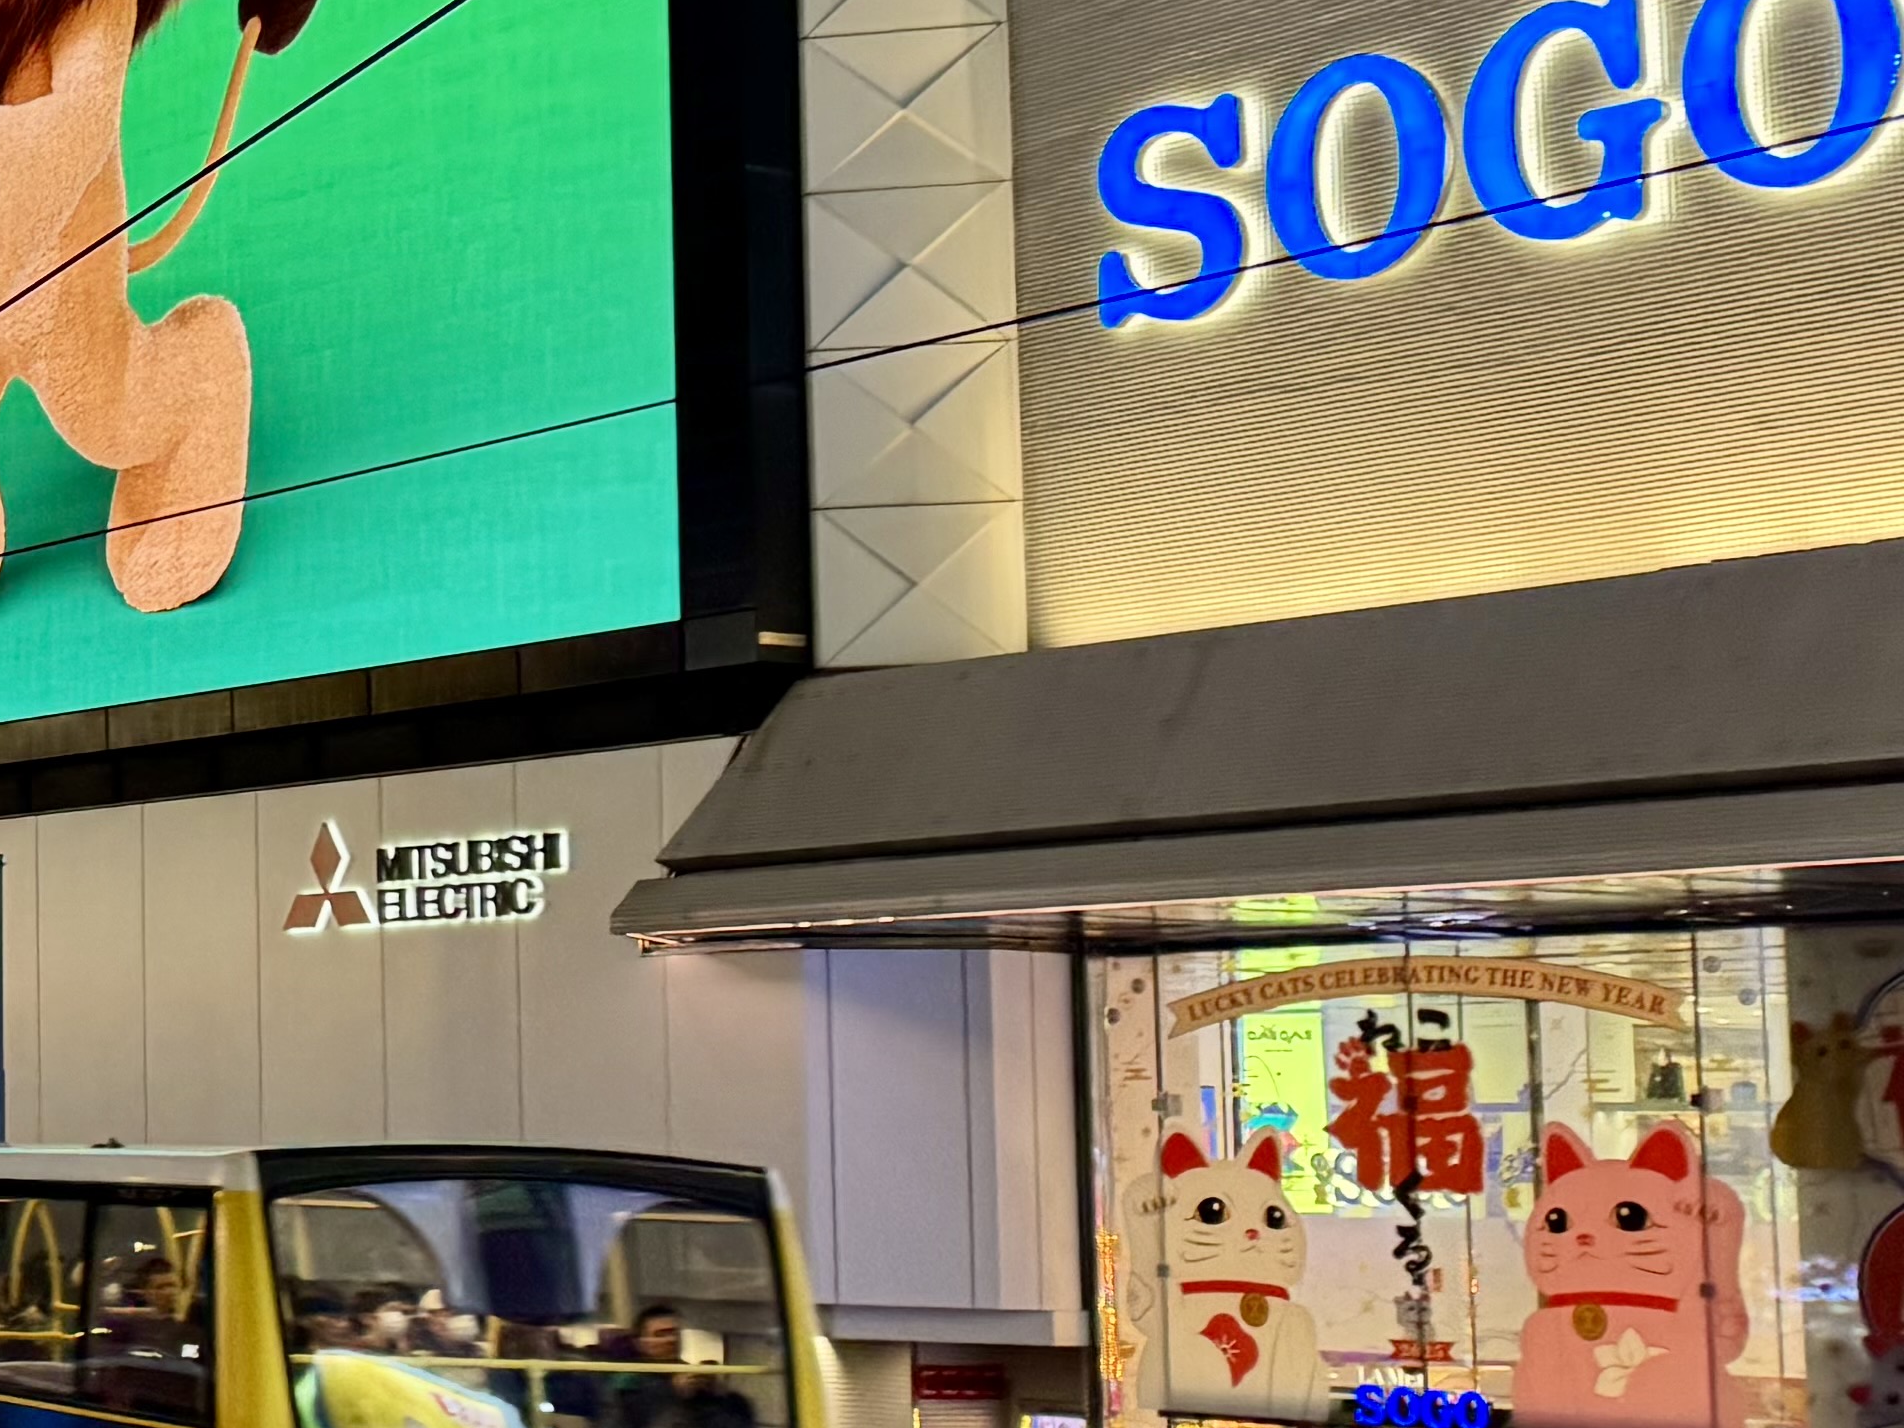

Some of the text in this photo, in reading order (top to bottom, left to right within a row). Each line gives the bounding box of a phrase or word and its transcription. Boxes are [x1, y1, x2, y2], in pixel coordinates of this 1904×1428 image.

[376, 832, 562, 884] MITSUBISHI
[376, 877, 539, 923] ELECTRIC
[1187, 964, 1666, 1022] LUCKY CATS CELEBRATING THE NEW YEAR
[1323, 1038, 1485, 1194] 福
